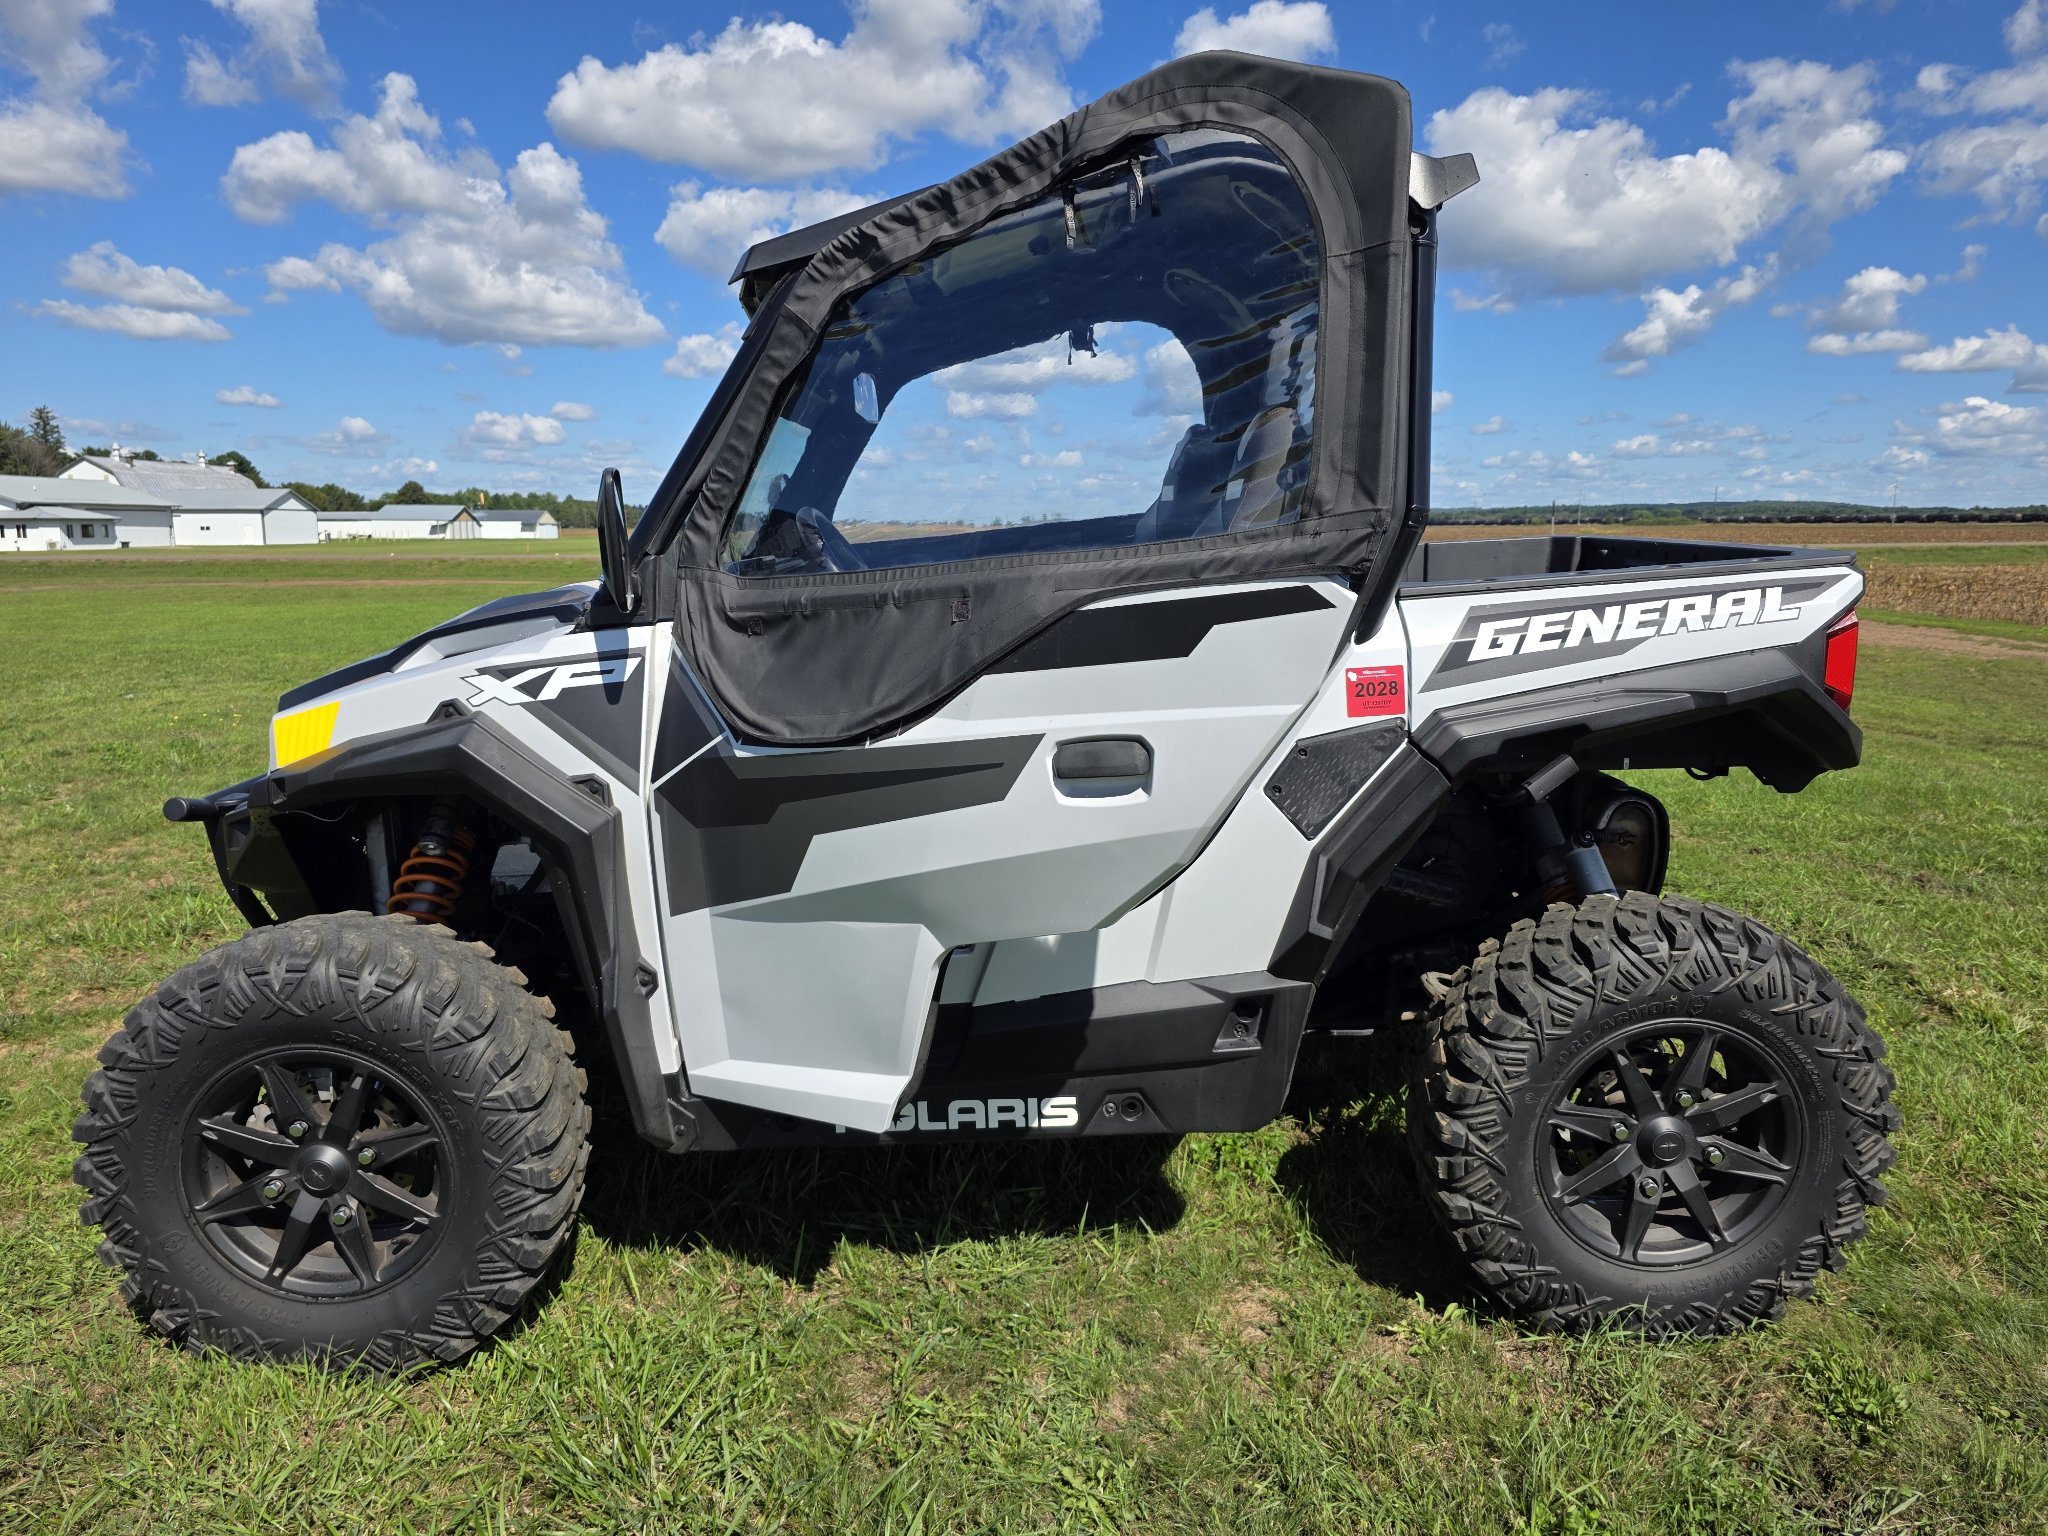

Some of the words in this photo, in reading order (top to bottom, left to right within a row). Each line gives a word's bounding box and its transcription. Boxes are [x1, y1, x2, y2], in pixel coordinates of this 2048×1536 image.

[1467, 586, 1801, 662] GENERAL
[462, 656, 643, 706] XP
[1355, 681, 1398, 697] 2028
[836, 1096, 1080, 1133] OLARIS
